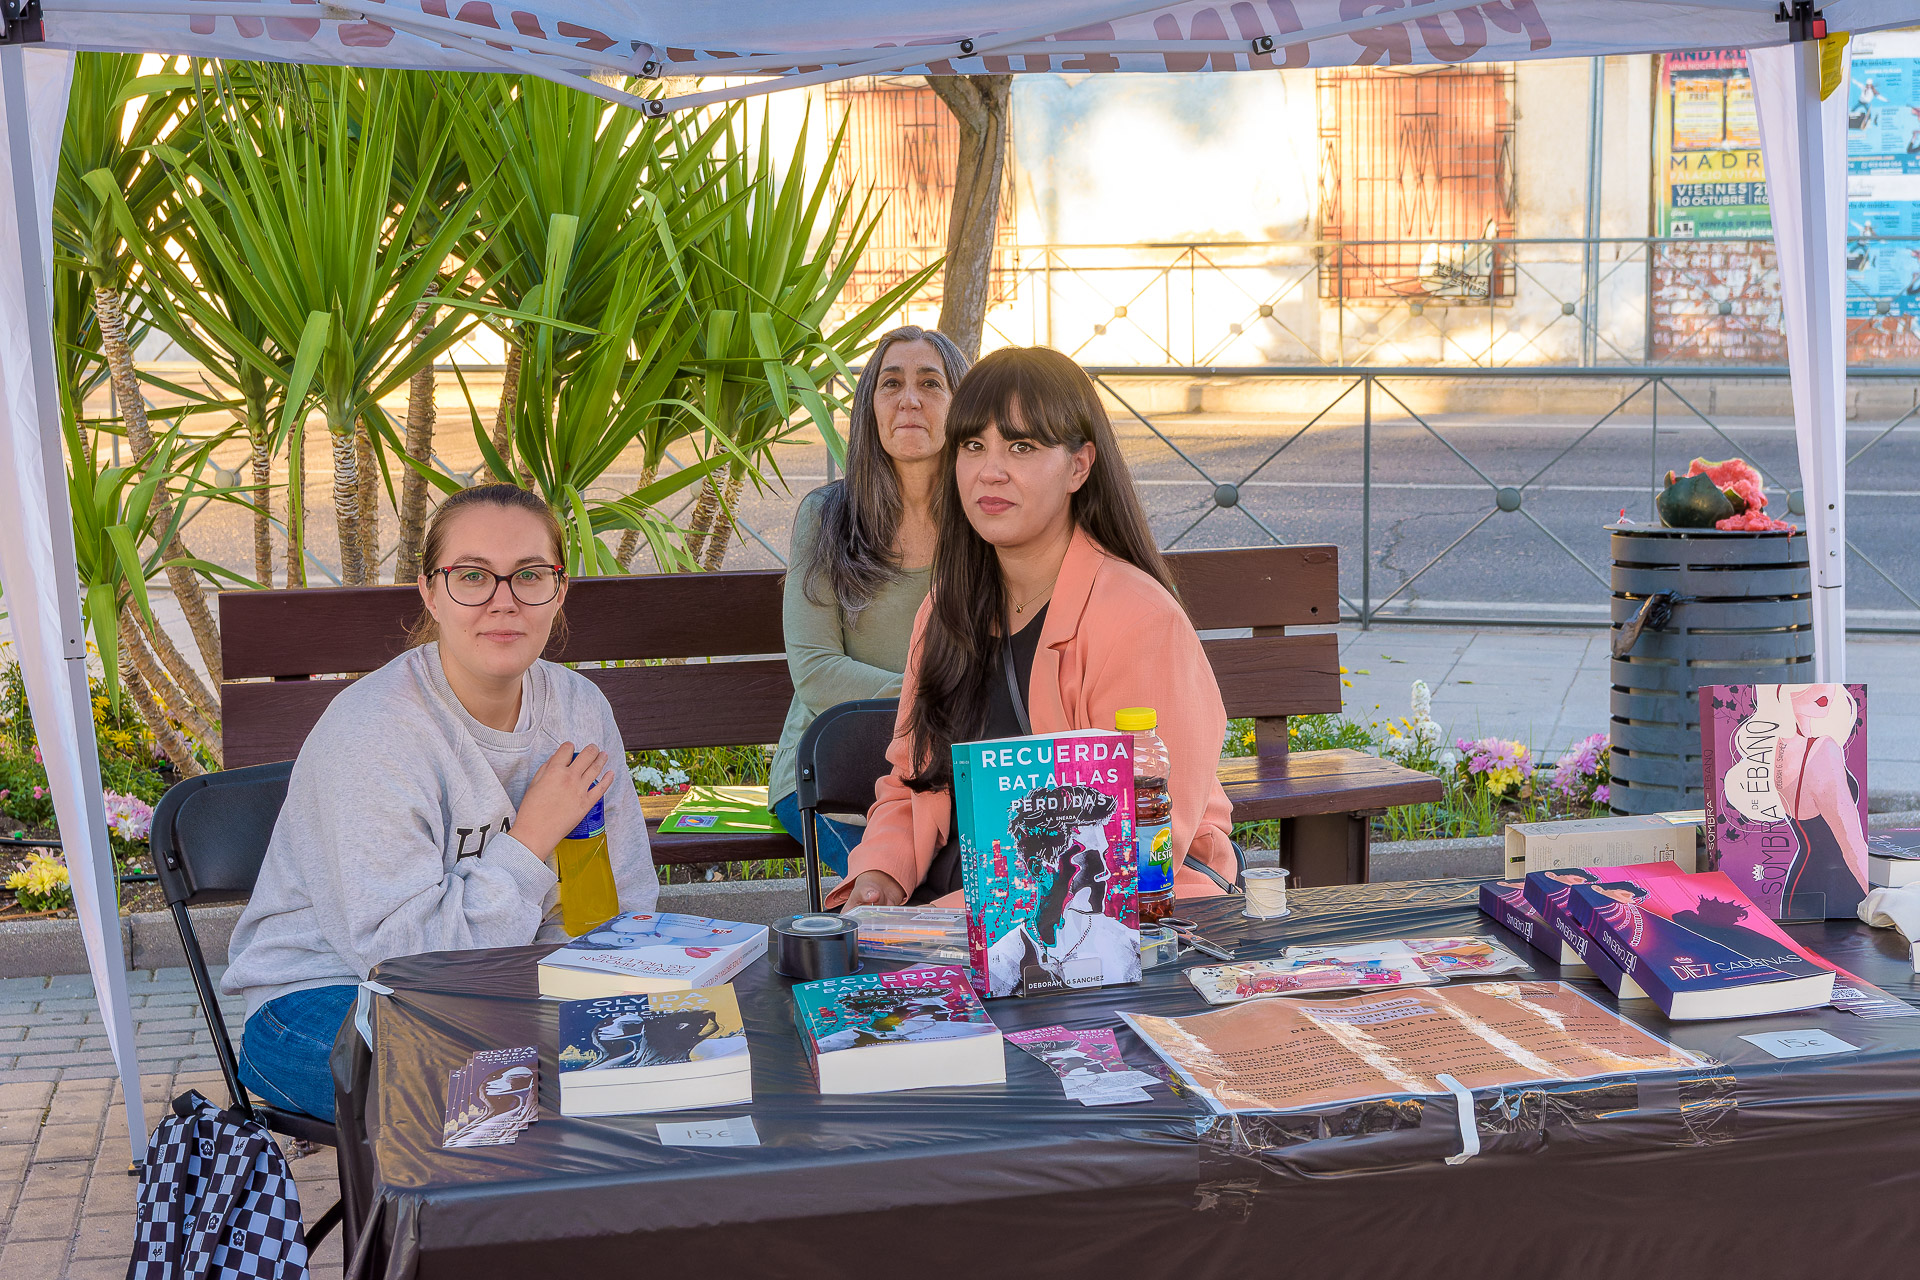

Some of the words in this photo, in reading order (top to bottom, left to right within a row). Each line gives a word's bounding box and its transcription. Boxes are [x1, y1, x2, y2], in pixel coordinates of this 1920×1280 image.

[1669, 63, 1686, 71] UNA
[1687, 62, 1716, 70] NOCHE
[1670, 153, 1760, 170] MADR
[1669, 170, 1722, 181] PALACIO
[1676, 184, 1748, 197] VIERNES
[1676, 196, 1690, 207] 10
[1691, 195, 1747, 207] OCTUBRE
[1699, 221, 1734, 229] VENTAS
[981, 742, 1129, 768] RECUERDA
[1739, 720, 1780, 793] ÉBANO
[999, 768, 1119, 792] BATALLAS
[1011, 794, 1107, 813] PERDIDAS
[1751, 799, 1759, 811] DE
[1706, 799, 1716, 850] SOMBRA
[1760, 805, 1791, 895] SOMBRA
[960, 833, 972, 912] RECUERDA
[966, 838, 977, 904] BATALLAS
[972, 847, 980, 901] PERDIDAS
[1764, 898, 1772, 911] LA
[1506, 912, 1525, 933] CADENAS
[1555, 917, 1578, 946] CADENAS
[1576, 935, 1589, 956] DIEZ
[1602, 930, 1626, 961] CADENAS
[1624, 950, 1638, 972] DIEZ
[1669, 963, 1718, 981] DIEZ
[1714, 954, 1803, 972] CADENAS
[804, 970, 960, 991] RECUERDA
[823, 979, 952, 994] BATALLAS
[1028, 980, 1062, 990] DEBORAH
[1072, 975, 1105, 985] SANCHEZ
[592, 992, 704, 1007] OLVIDA
[837, 987, 942, 999] PERDIDAS
[586, 998, 710, 1014] GUERRAS
[597, 1006, 704, 1019] VENCIDAS
[1350, 1004, 1373, 1012] DEL
[1374, 998, 1415, 1009] LIBRO
[1336, 1011, 1387, 1019] OCTUBRE
[1374, 1014, 1398, 1022] SAN
[1007, 1026, 1064, 1039] RECUERDA
[479, 1046, 535, 1056] OLVIDA
[1777, 1038, 1825, 1049] 15€
[475, 1050, 537, 1060] GUERRAS
[686, 1129, 733, 1139] 15€
